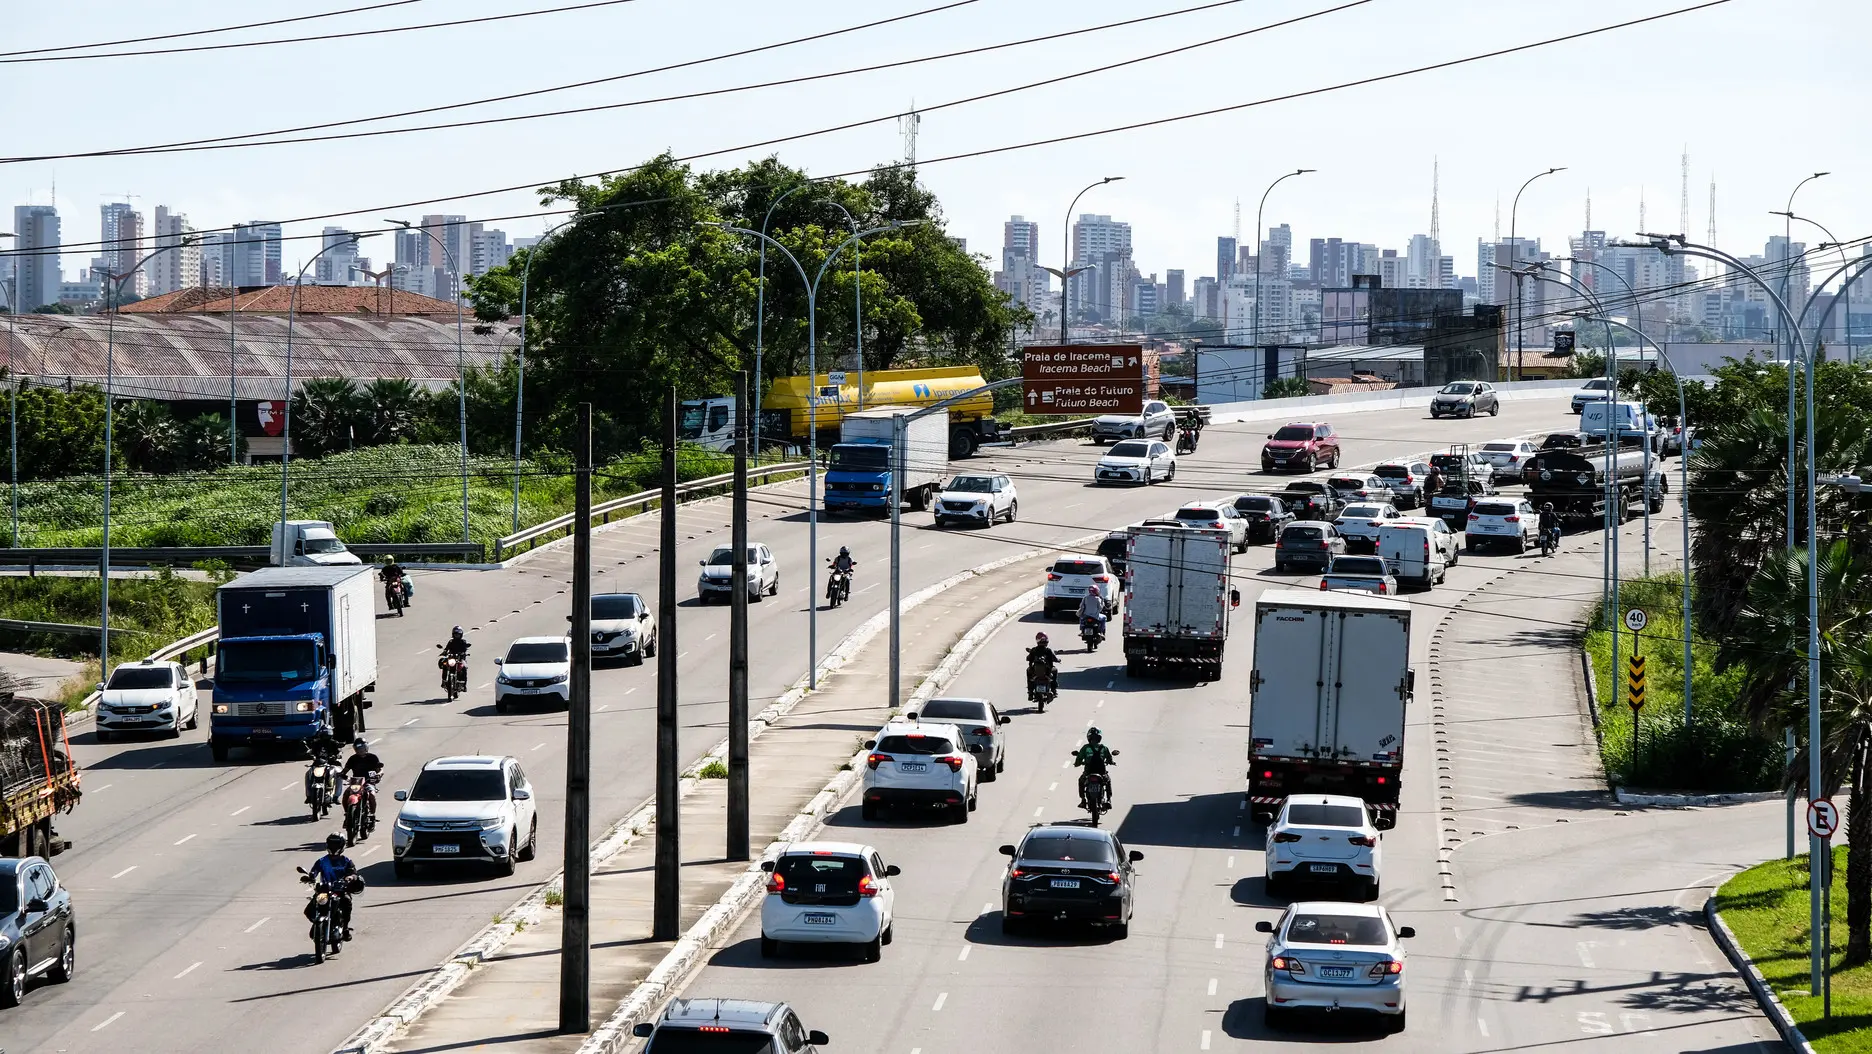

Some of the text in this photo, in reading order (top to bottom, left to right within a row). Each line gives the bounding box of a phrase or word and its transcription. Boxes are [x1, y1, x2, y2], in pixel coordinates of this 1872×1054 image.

[1024, 351, 1111, 362] Praia de Iracema
[1039, 363, 1111, 373] Iracema Beach
[1055, 386, 1134, 396] Praia do Futuro
[1055, 398, 1119, 408] Futuro Beach
[1629, 612, 1643, 622] 40
[1816, 806, 1828, 829] E
[815, 883, 826, 892] FIAT
